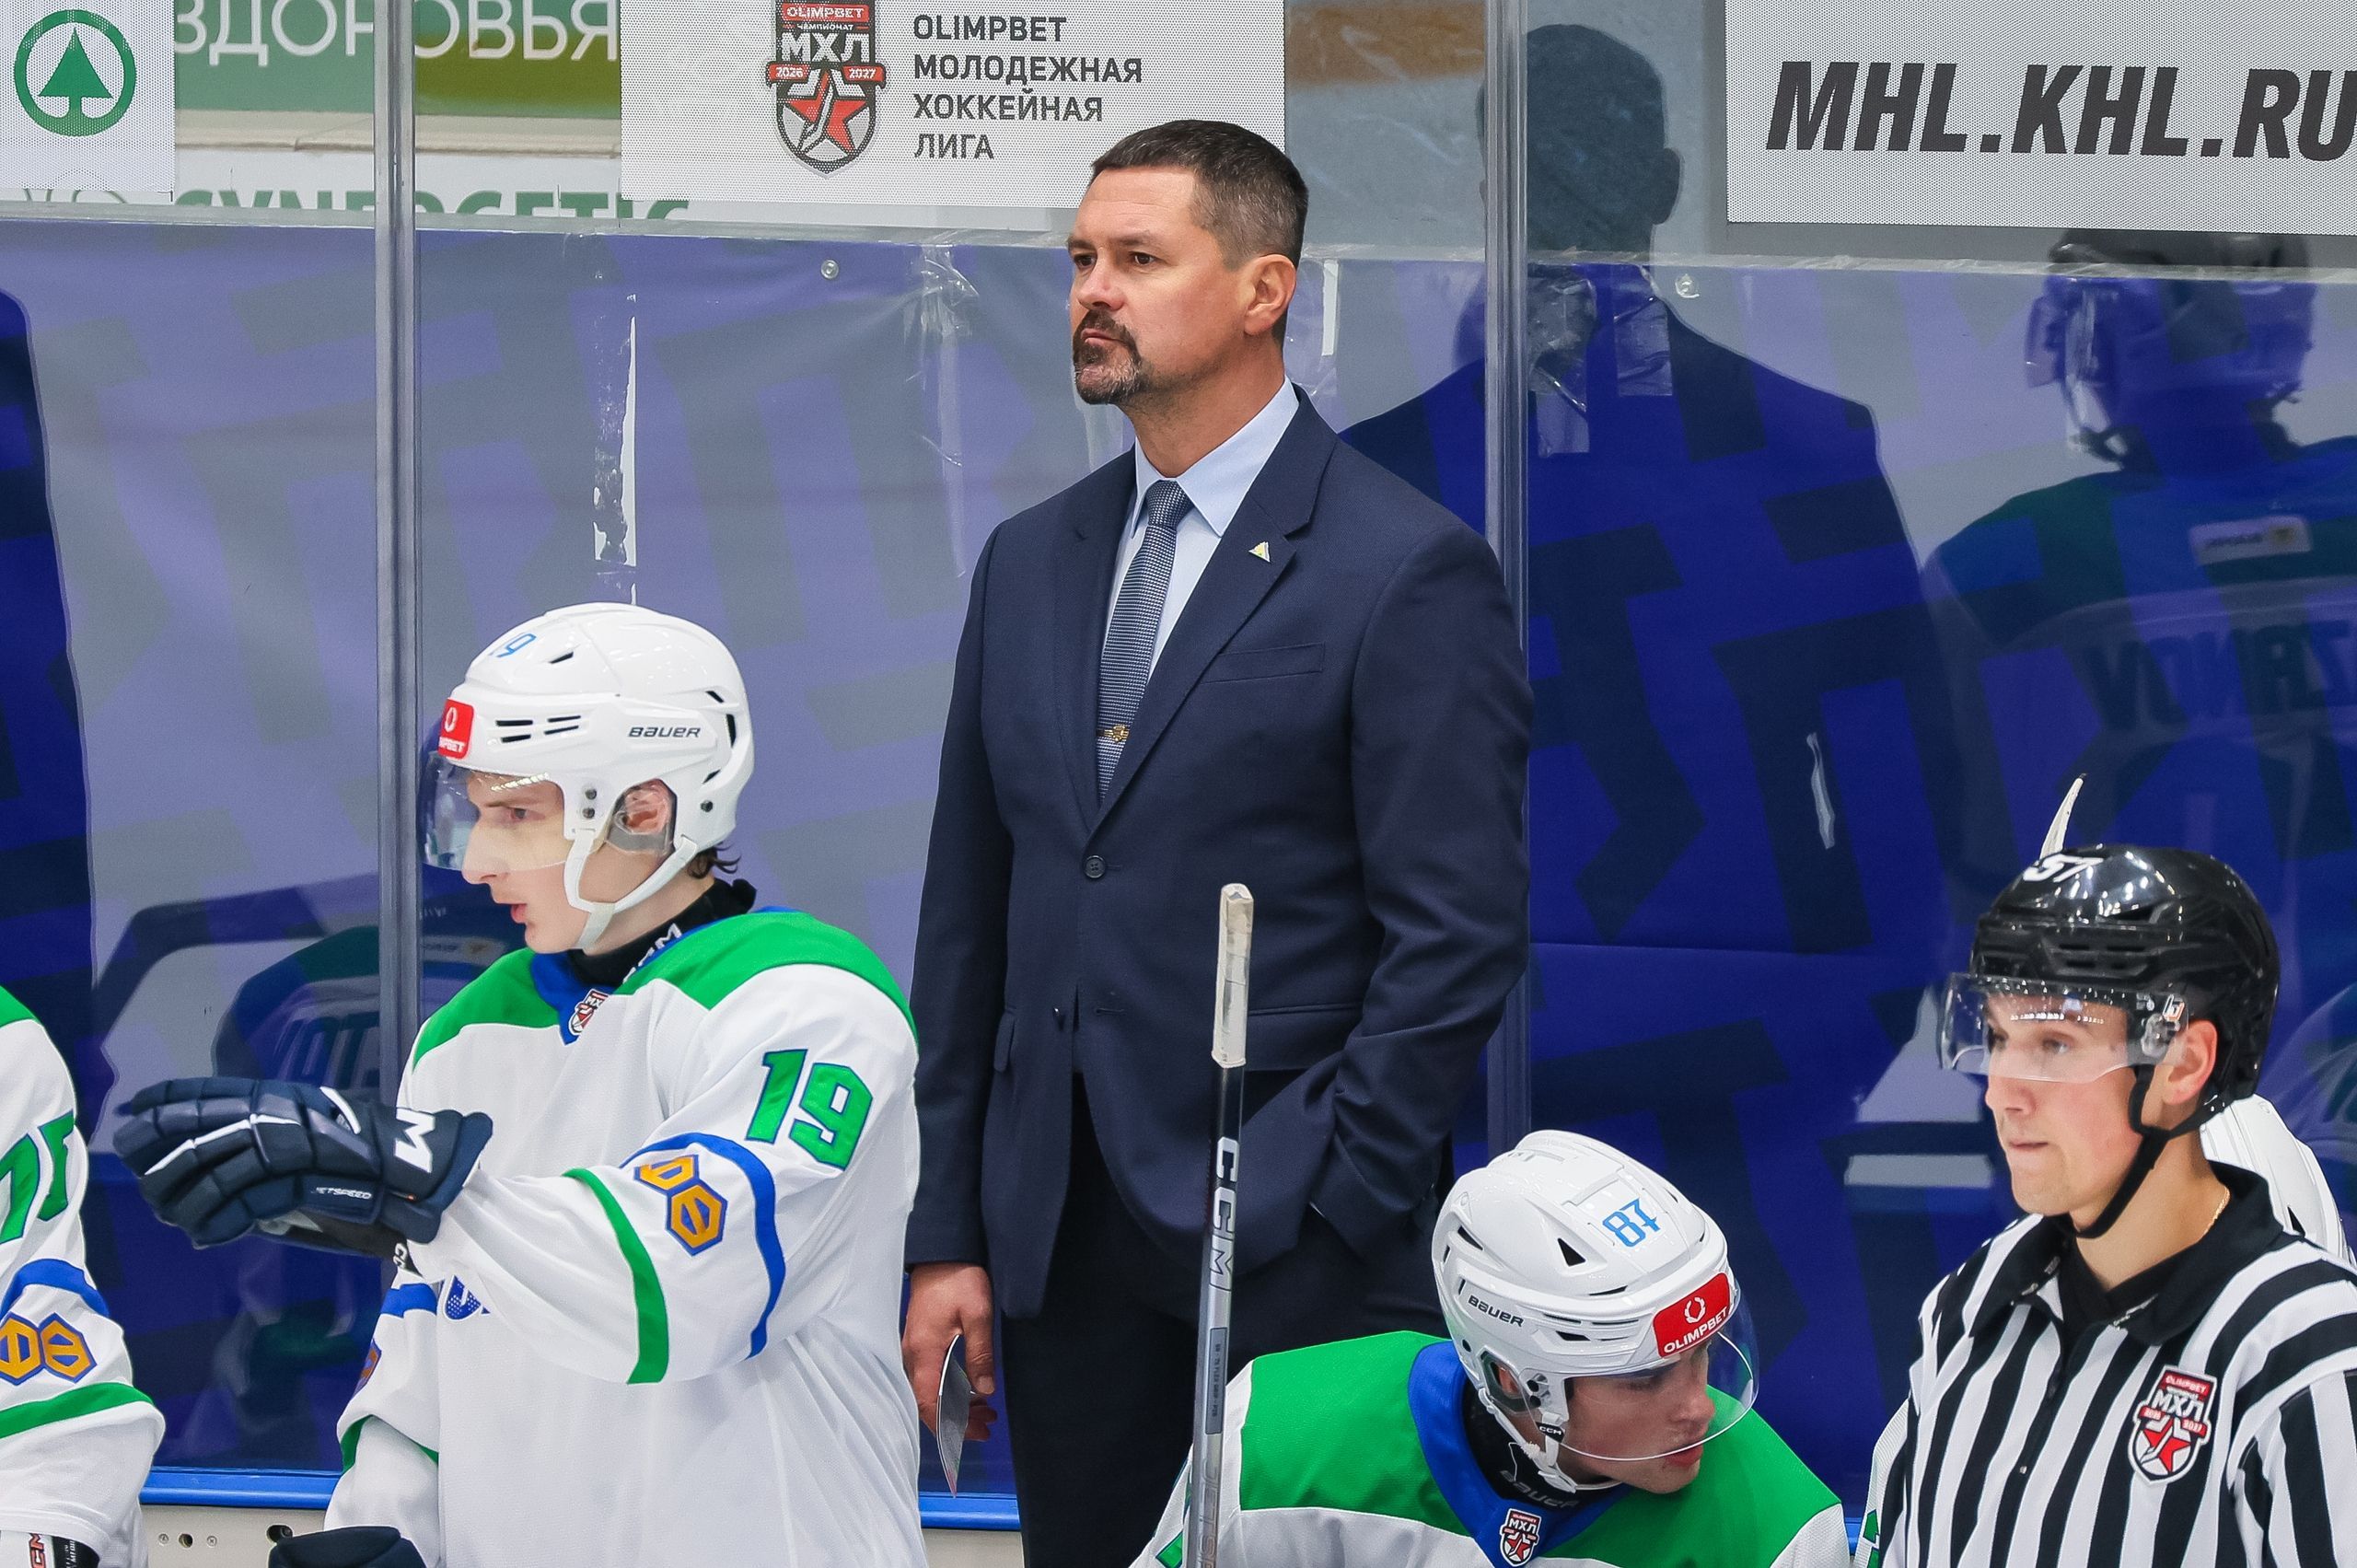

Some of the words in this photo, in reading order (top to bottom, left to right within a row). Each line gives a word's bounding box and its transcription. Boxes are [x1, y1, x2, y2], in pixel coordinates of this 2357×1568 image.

[786, 6, 865, 18] OLIMPBET
[913, 15, 1067, 42] OLIMPBET
[781, 32, 870, 63] МХЛ
[914, 54, 1143, 85] МОЛОДЕЖНАЯ
[913, 88, 1104, 122] ХОККЕЙНАЯ
[1766, 62, 2357, 162] MHL.KHL.RU
[913, 133, 994, 159] ЛИГА
[744, 1048, 874, 1171] 19
[1207, 1136, 1241, 1292] CCM
[1602, 1197, 1661, 1249] 87
[1468, 1295, 1525, 1328] BAUER
[1663, 1306, 1728, 1353] OLIMPBET
[2151, 1389, 2204, 1422] МХЛ
[1508, 1517, 1538, 1535] МХЛ
